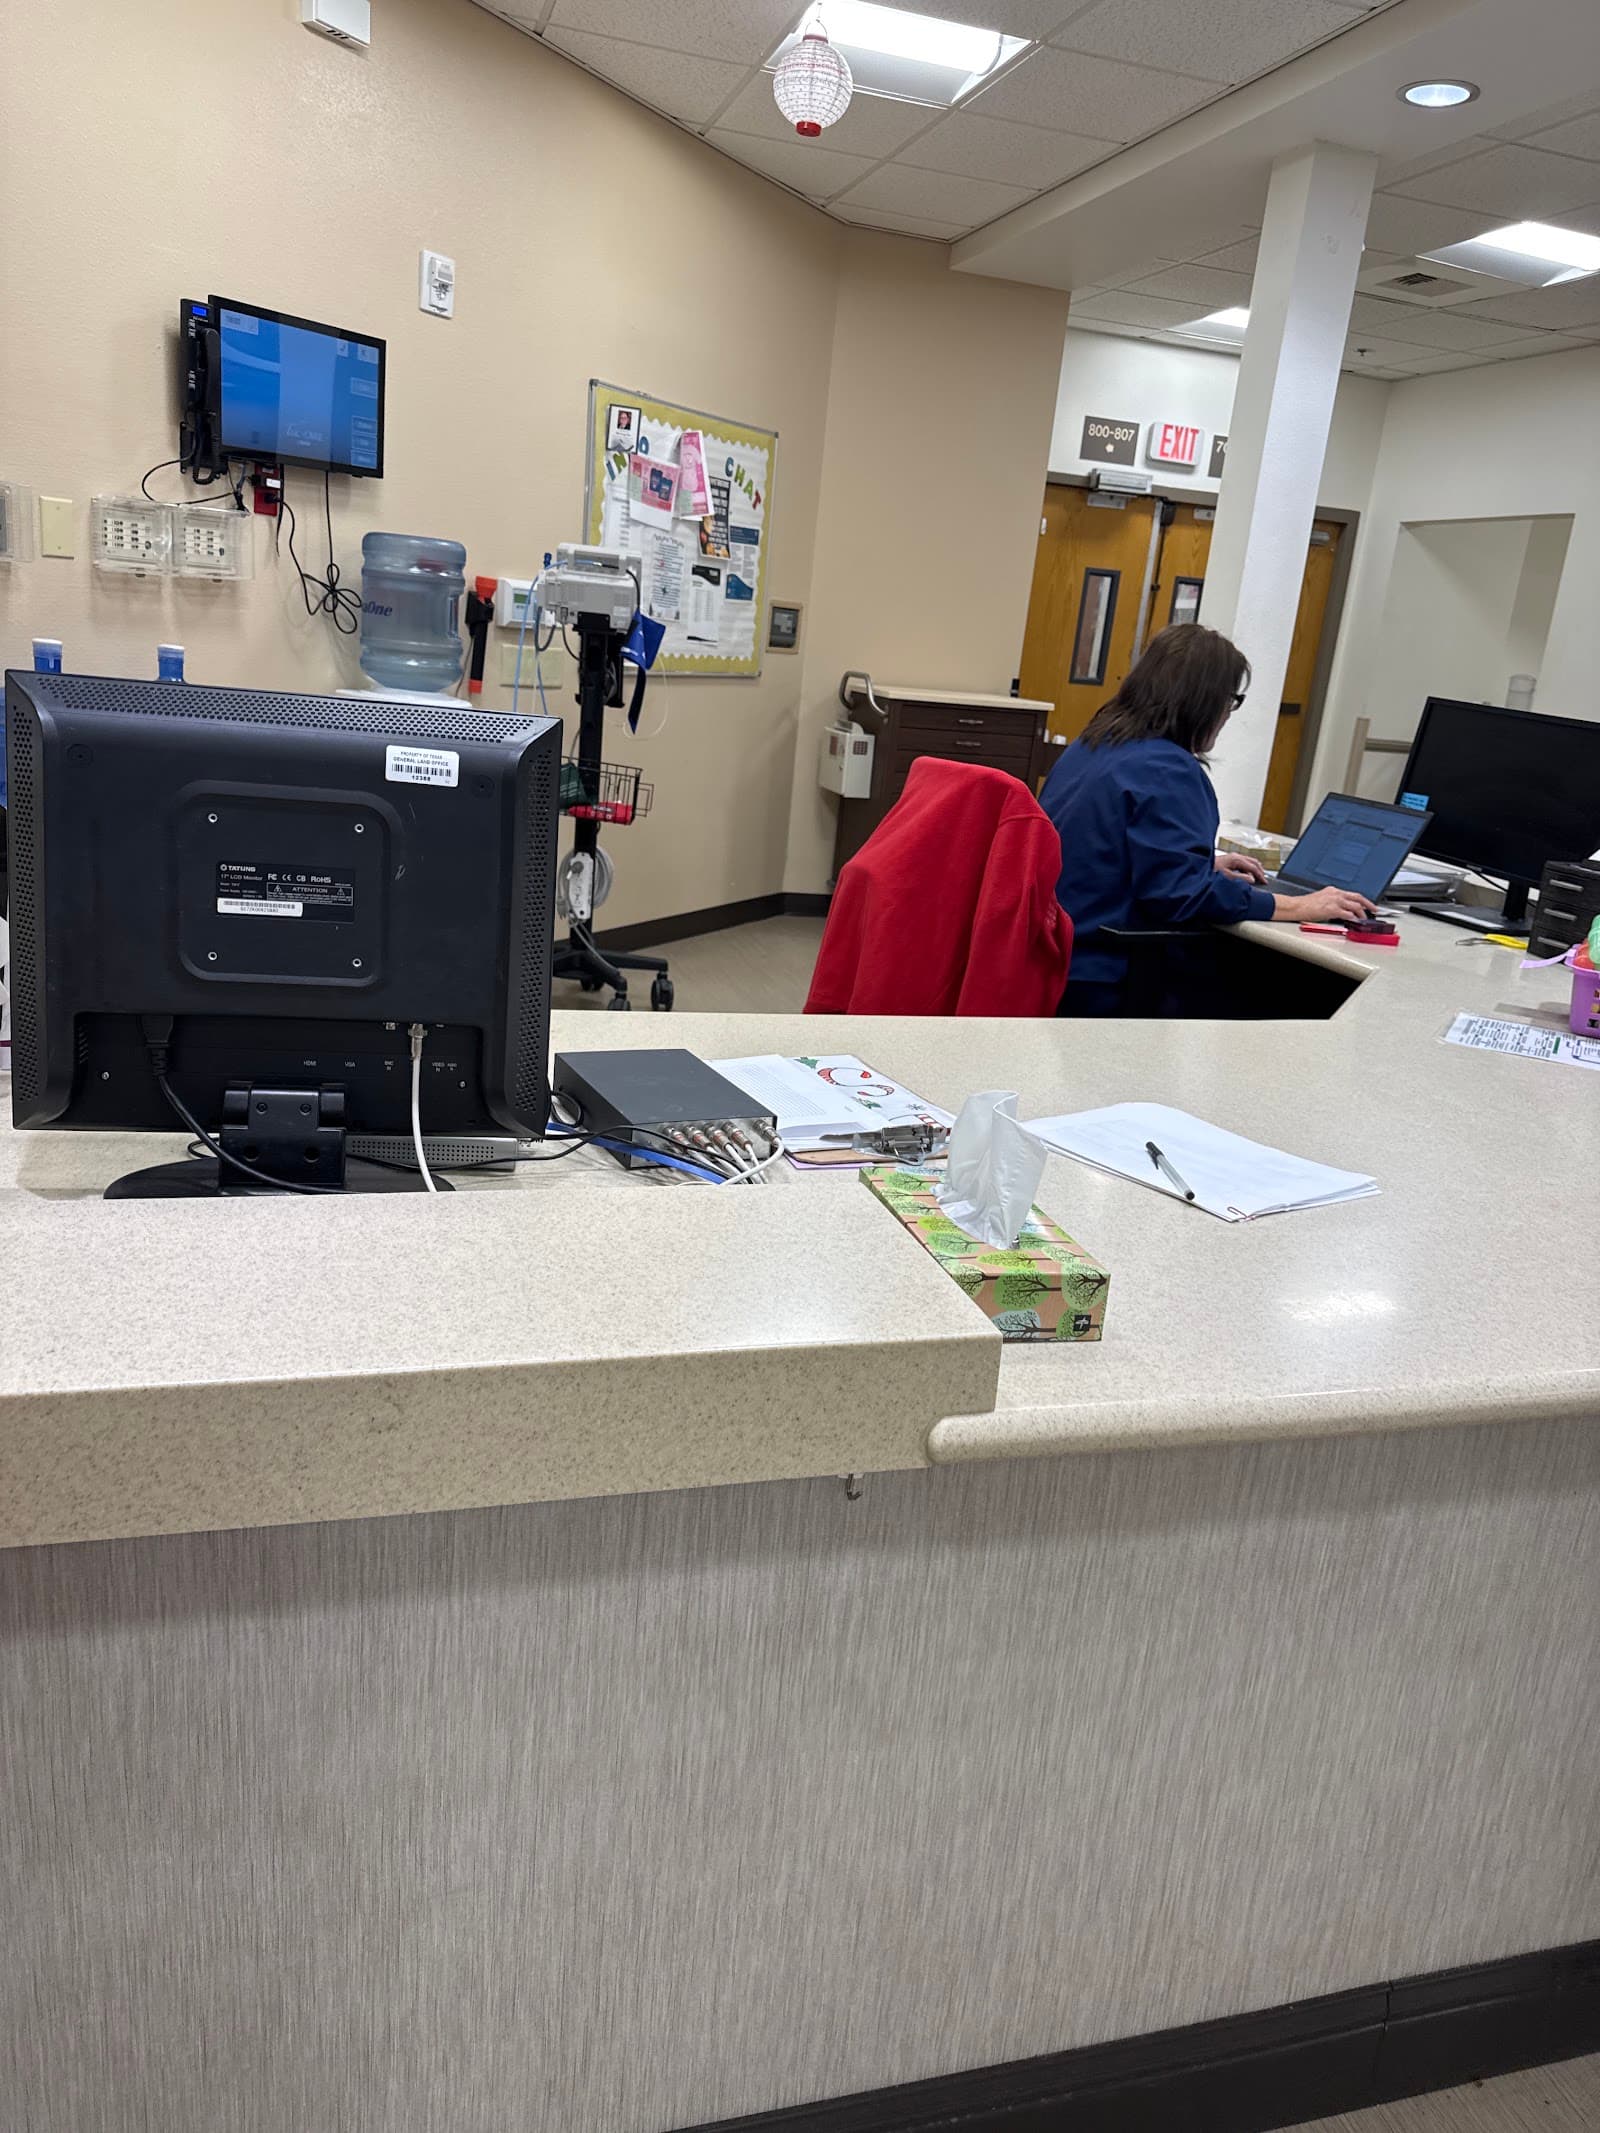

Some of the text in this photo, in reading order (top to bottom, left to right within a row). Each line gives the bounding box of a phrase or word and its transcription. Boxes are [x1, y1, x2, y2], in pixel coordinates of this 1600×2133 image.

[1088, 423, 1136, 442] 800-807
[1159, 424, 1200, 462] EXIT
[724, 456, 762, 510] CHAT
[393, 756, 416, 764] GENERAL
[292, 886, 328, 894] ATTENTION
